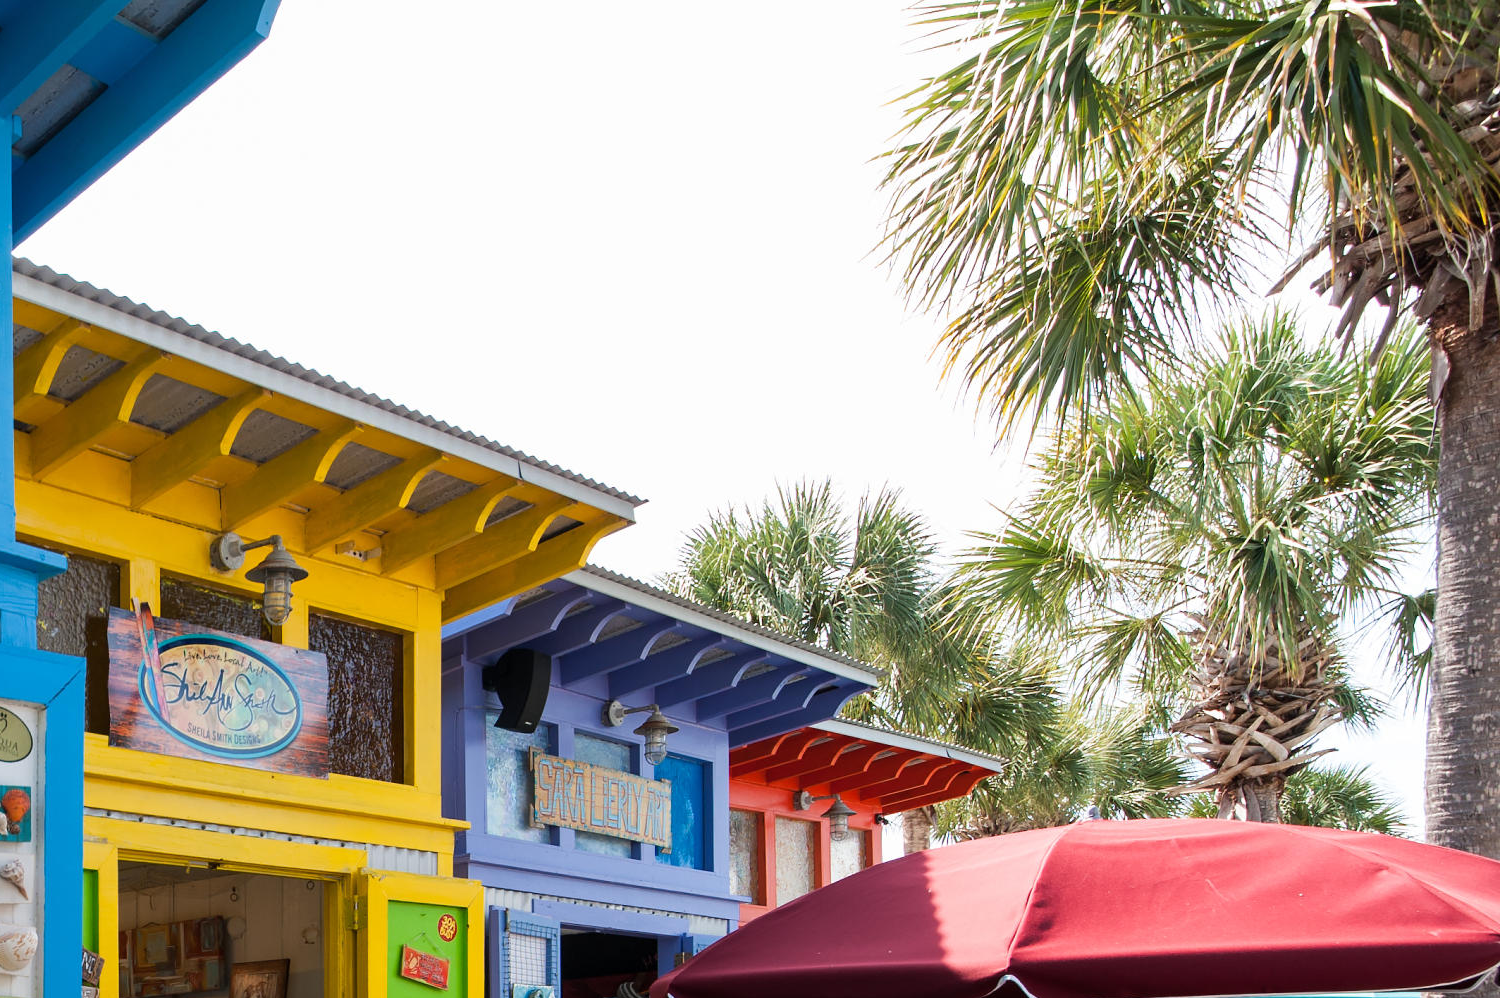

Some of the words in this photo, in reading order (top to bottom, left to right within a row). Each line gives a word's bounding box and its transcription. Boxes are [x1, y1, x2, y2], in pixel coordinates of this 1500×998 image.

[187, 722, 211, 741] SHEILA
[212, 730, 233, 744] SMITH
[234, 734, 262, 745] DESIGNS
[538, 758, 586, 824] SARA
[645, 786, 669, 843] ART
